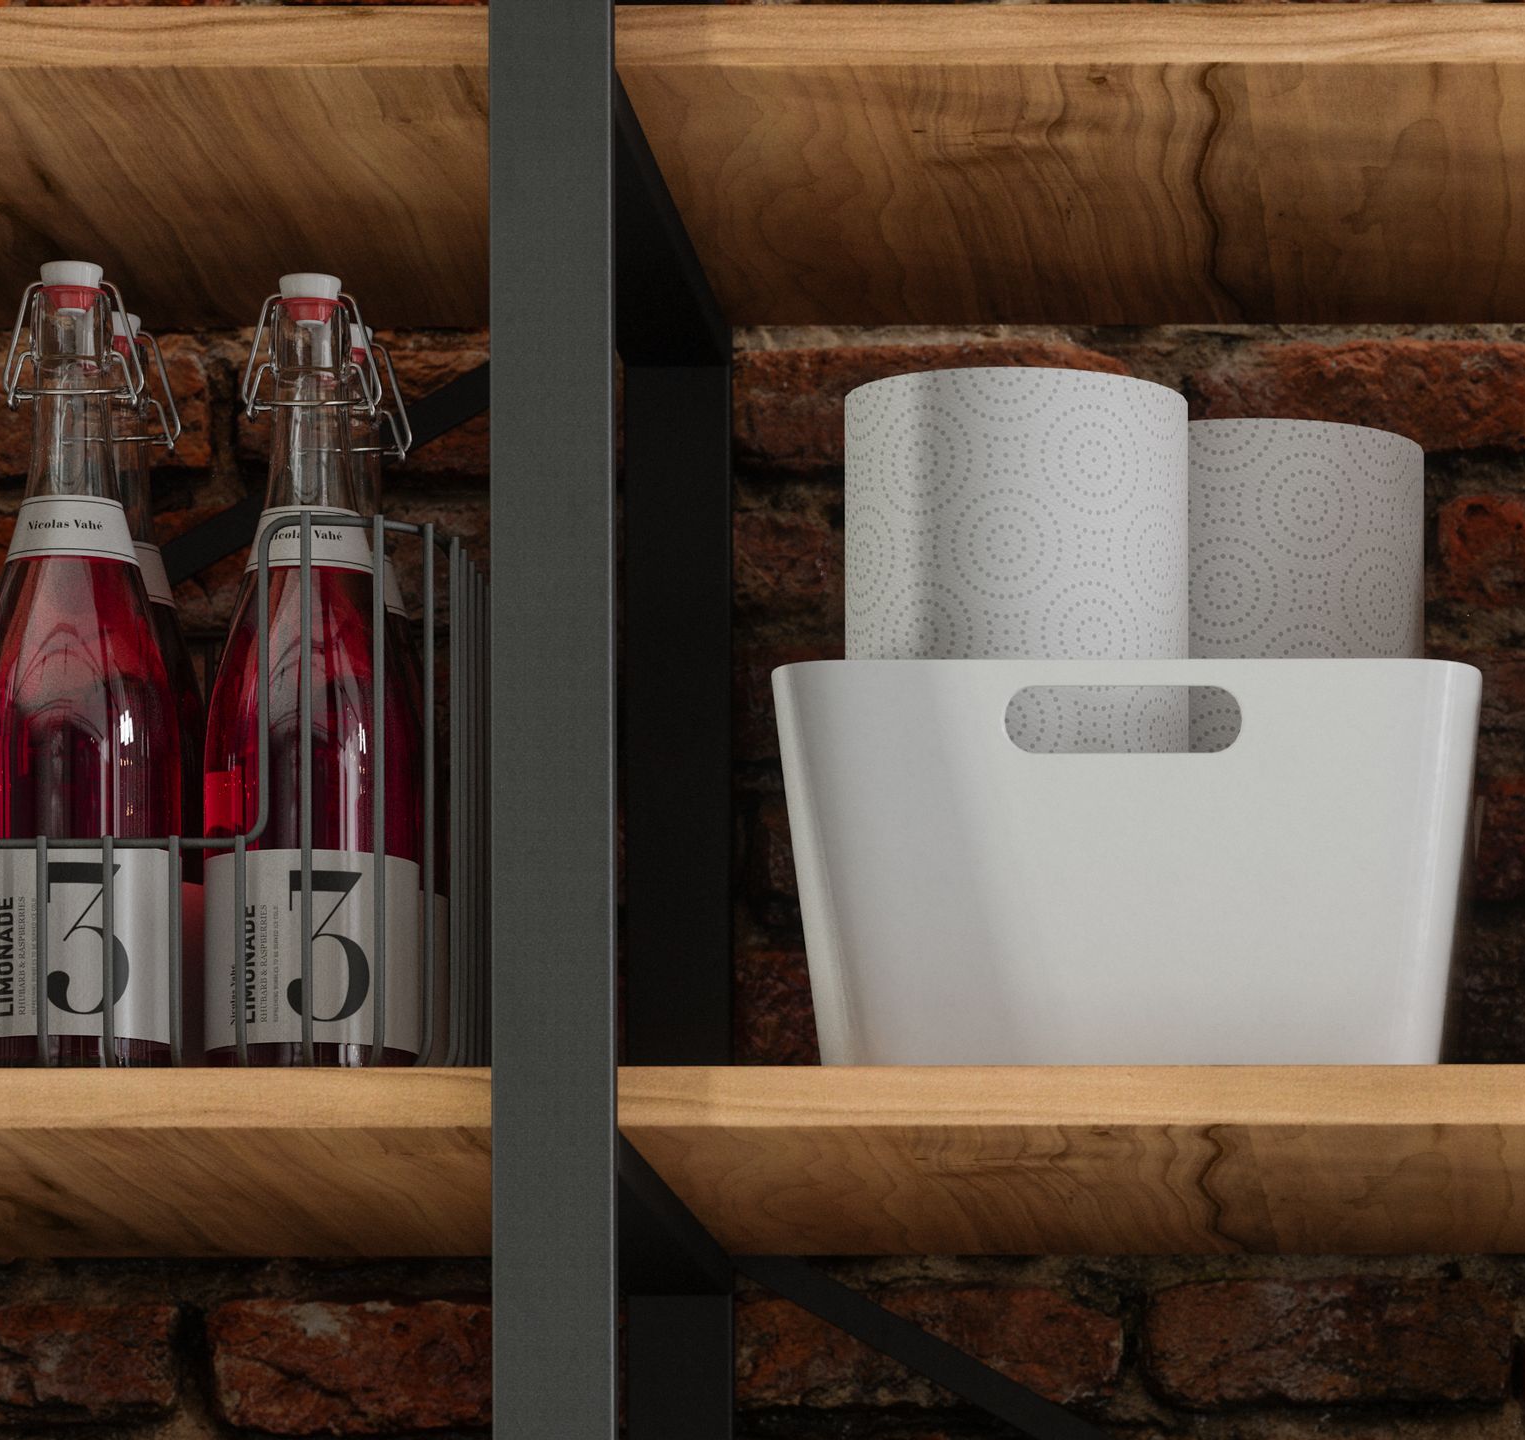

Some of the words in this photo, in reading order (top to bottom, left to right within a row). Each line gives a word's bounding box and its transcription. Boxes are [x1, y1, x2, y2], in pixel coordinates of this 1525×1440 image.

[27, 519, 69, 531] Nicolas
[73, 519, 103, 532] Vahé
[314, 530, 342, 542] Vahé
[46, 861, 130, 1015] 3
[245, 905, 255, 1024] LIMONADE
[287, 869, 370, 1022] 3
